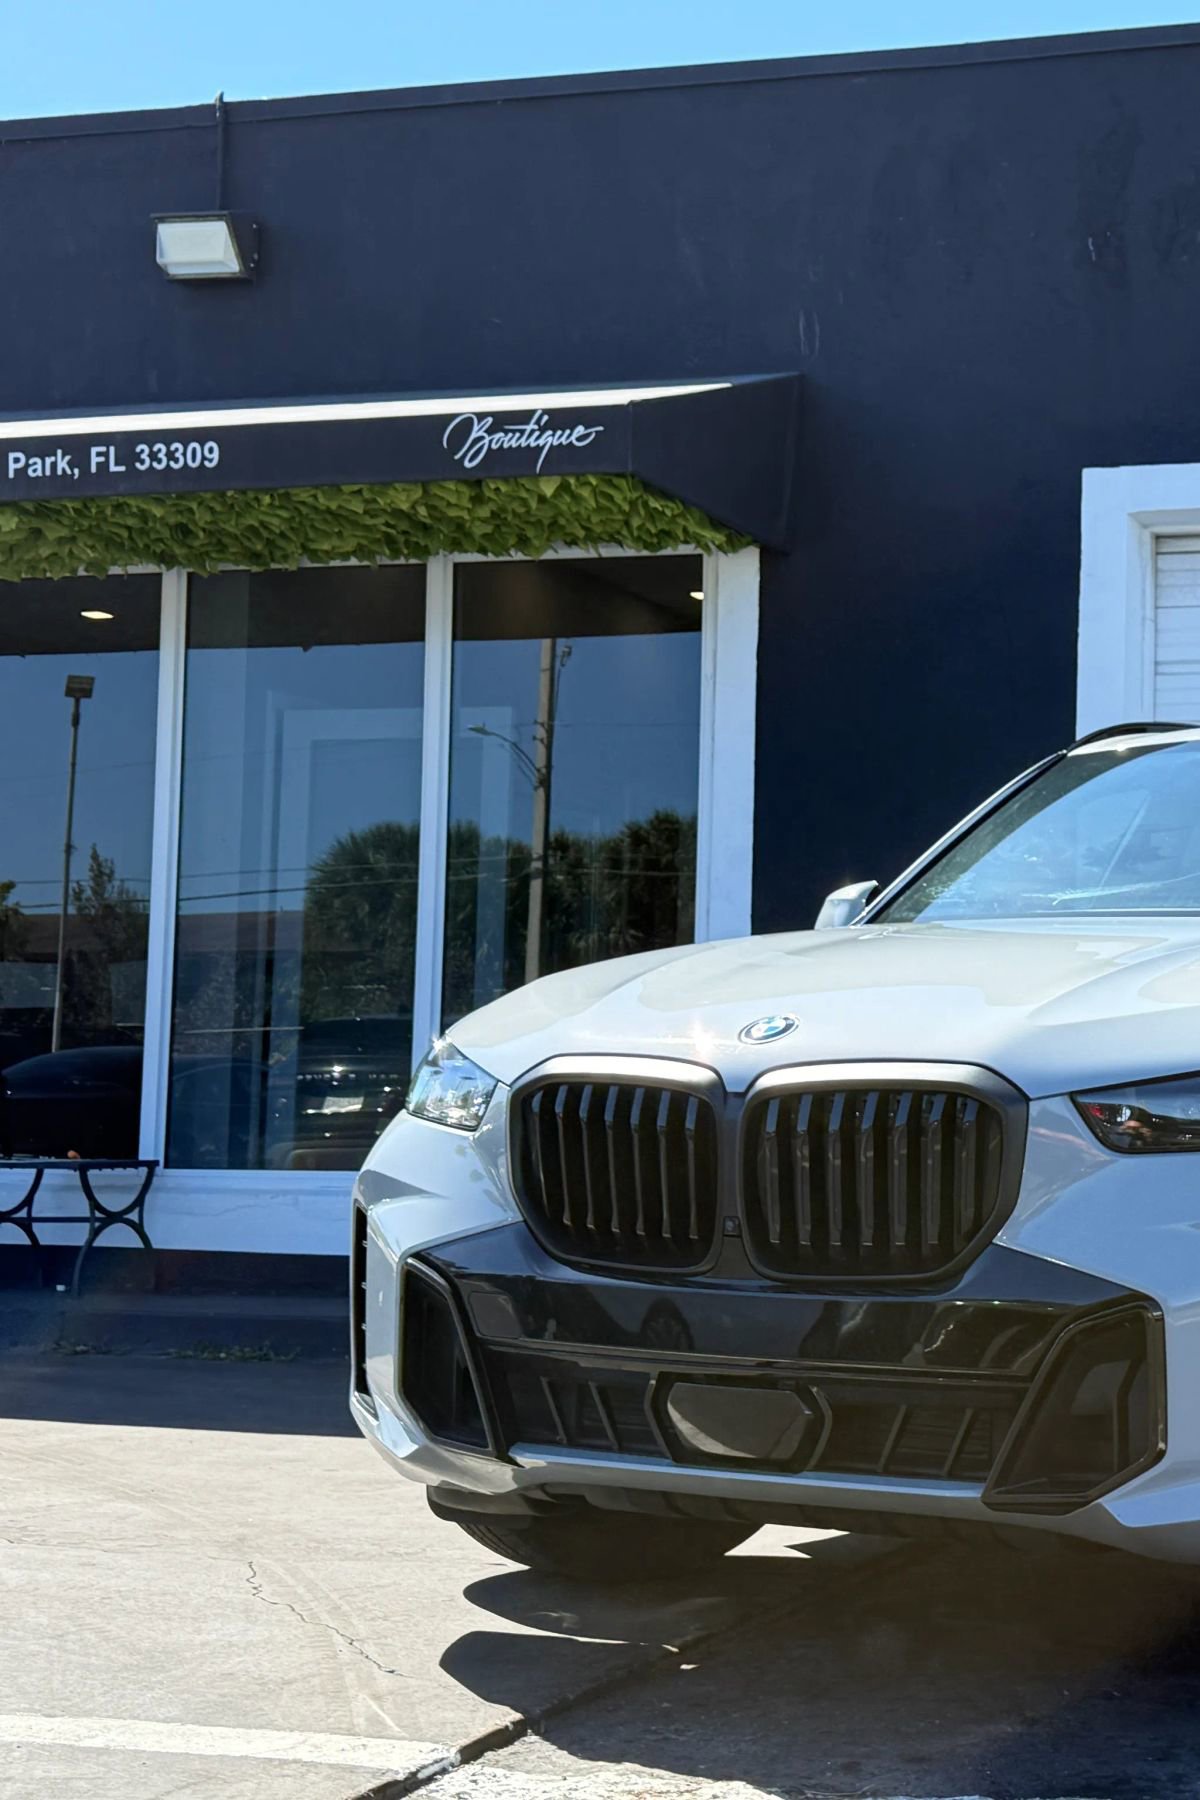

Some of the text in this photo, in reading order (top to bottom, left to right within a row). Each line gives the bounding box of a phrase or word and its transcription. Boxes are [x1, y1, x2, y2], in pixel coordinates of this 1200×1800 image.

[8, 440, 220, 480] Park, FL 33309
[442, 409, 605, 474] Boutique
